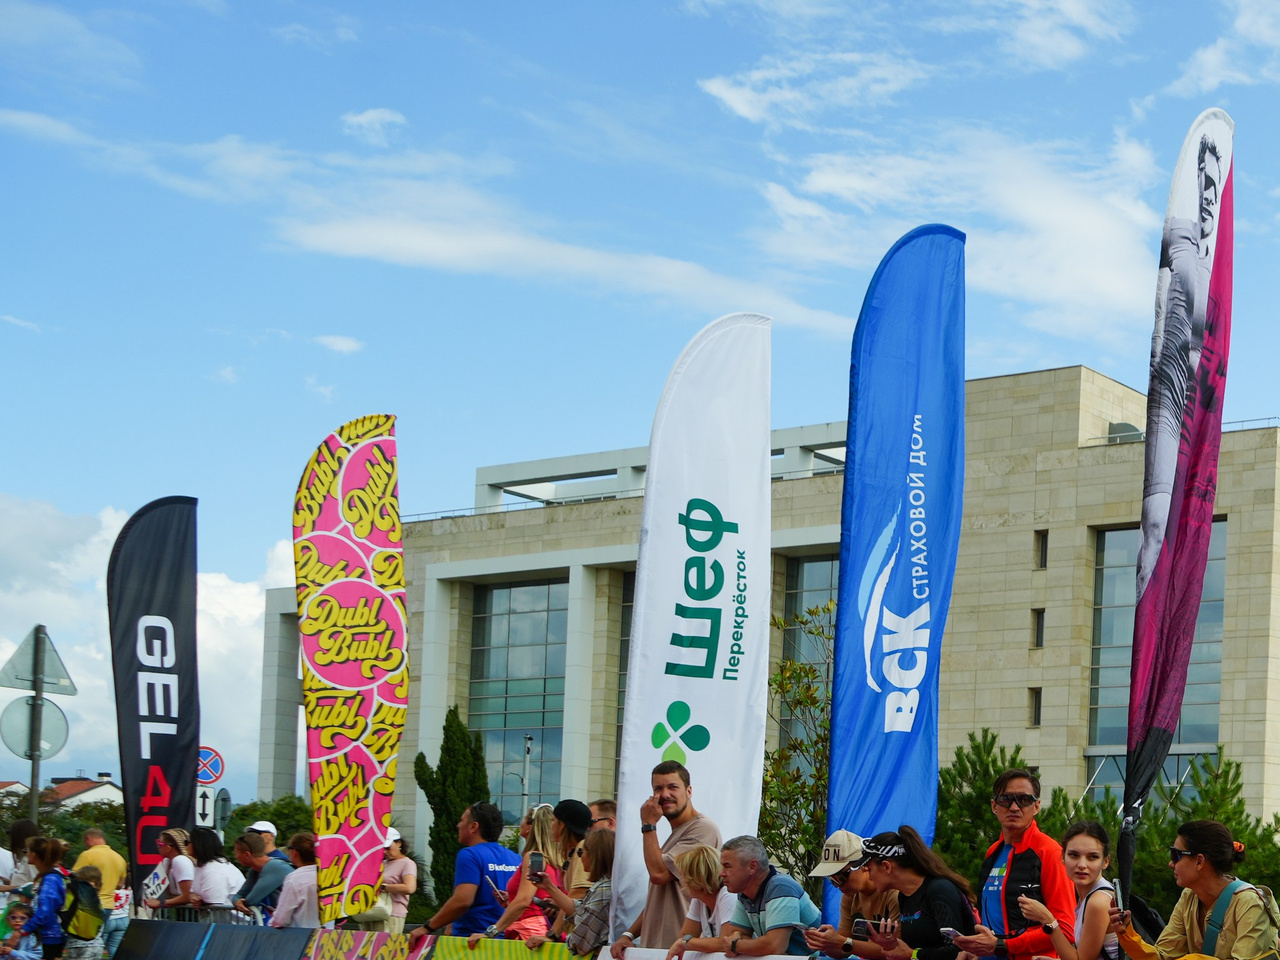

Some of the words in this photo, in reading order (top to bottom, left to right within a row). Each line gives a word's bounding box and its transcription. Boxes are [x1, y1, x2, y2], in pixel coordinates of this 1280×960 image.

[909, 413, 929, 468] ДОМ
[664, 498, 738, 679] Шеф
[910, 475, 932, 600] СТРАХОВОЙ
[301, 594, 387, 635] Dubl
[314, 627, 405, 679] Bubl
[722, 549, 747, 681] Перекрёсток
[884, 601, 932, 734] ВСК
[136, 615, 179, 865] GEL4U
